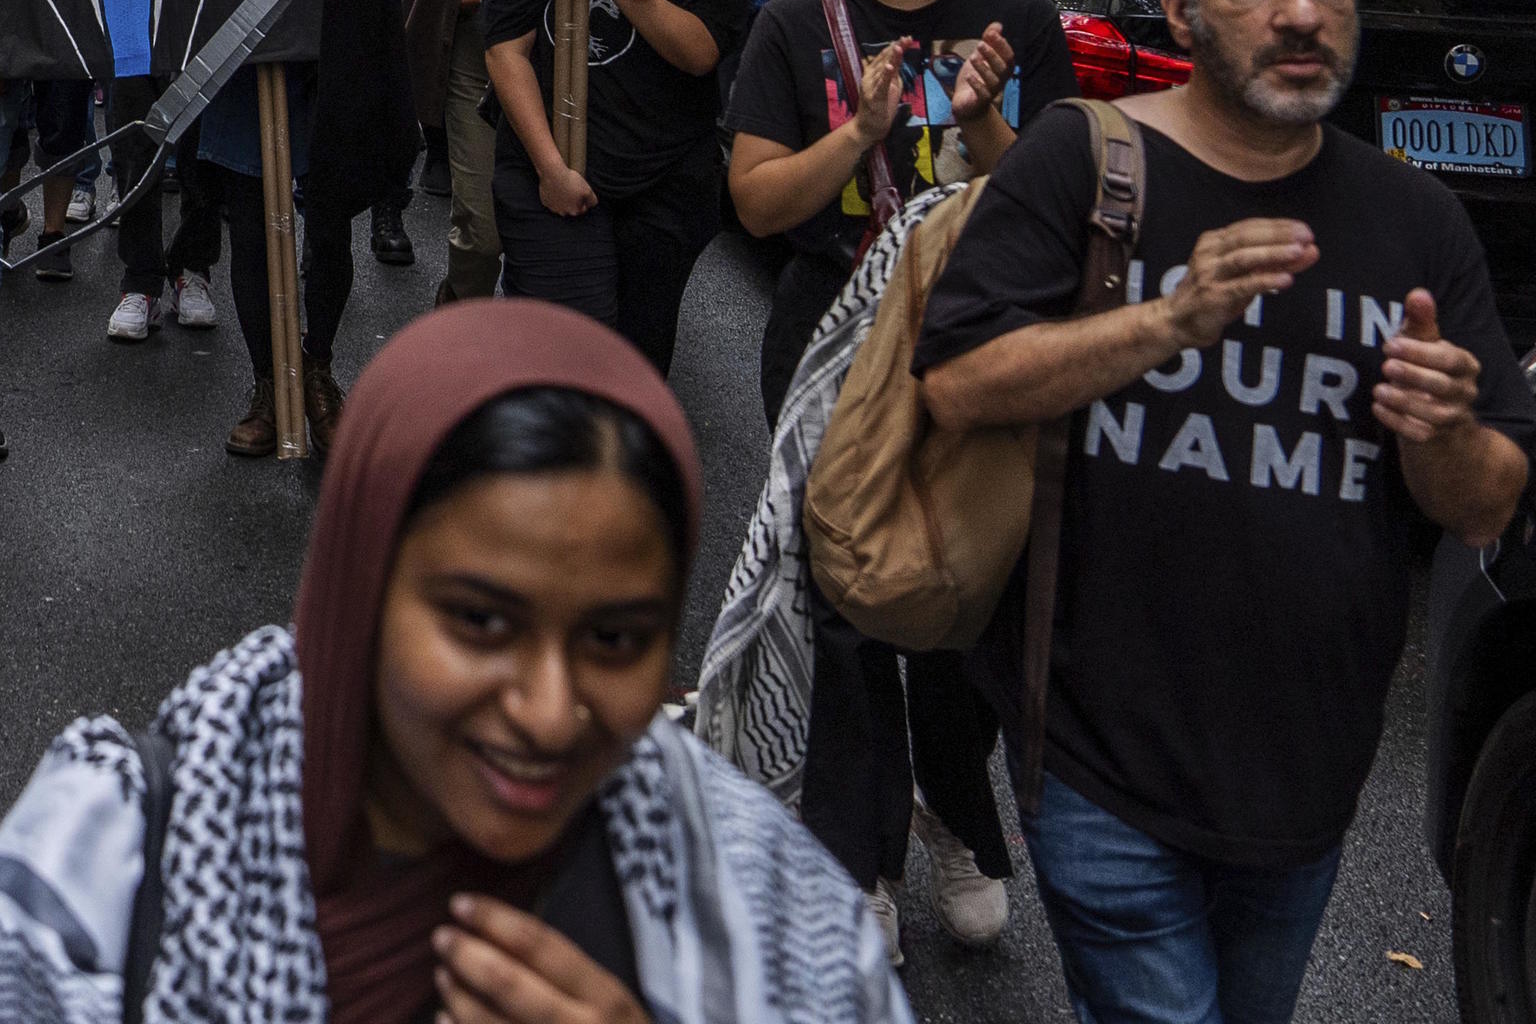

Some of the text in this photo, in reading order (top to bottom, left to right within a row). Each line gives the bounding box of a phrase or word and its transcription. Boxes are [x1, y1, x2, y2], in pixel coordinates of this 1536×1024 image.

[1392, 117, 1517, 158] 0001 DKD
[1424, 162, 1439, 171] of
[1441, 163, 1513, 175] Manhattan
[1325, 288, 1404, 348] IN
[1083, 399, 1383, 502] NAME
